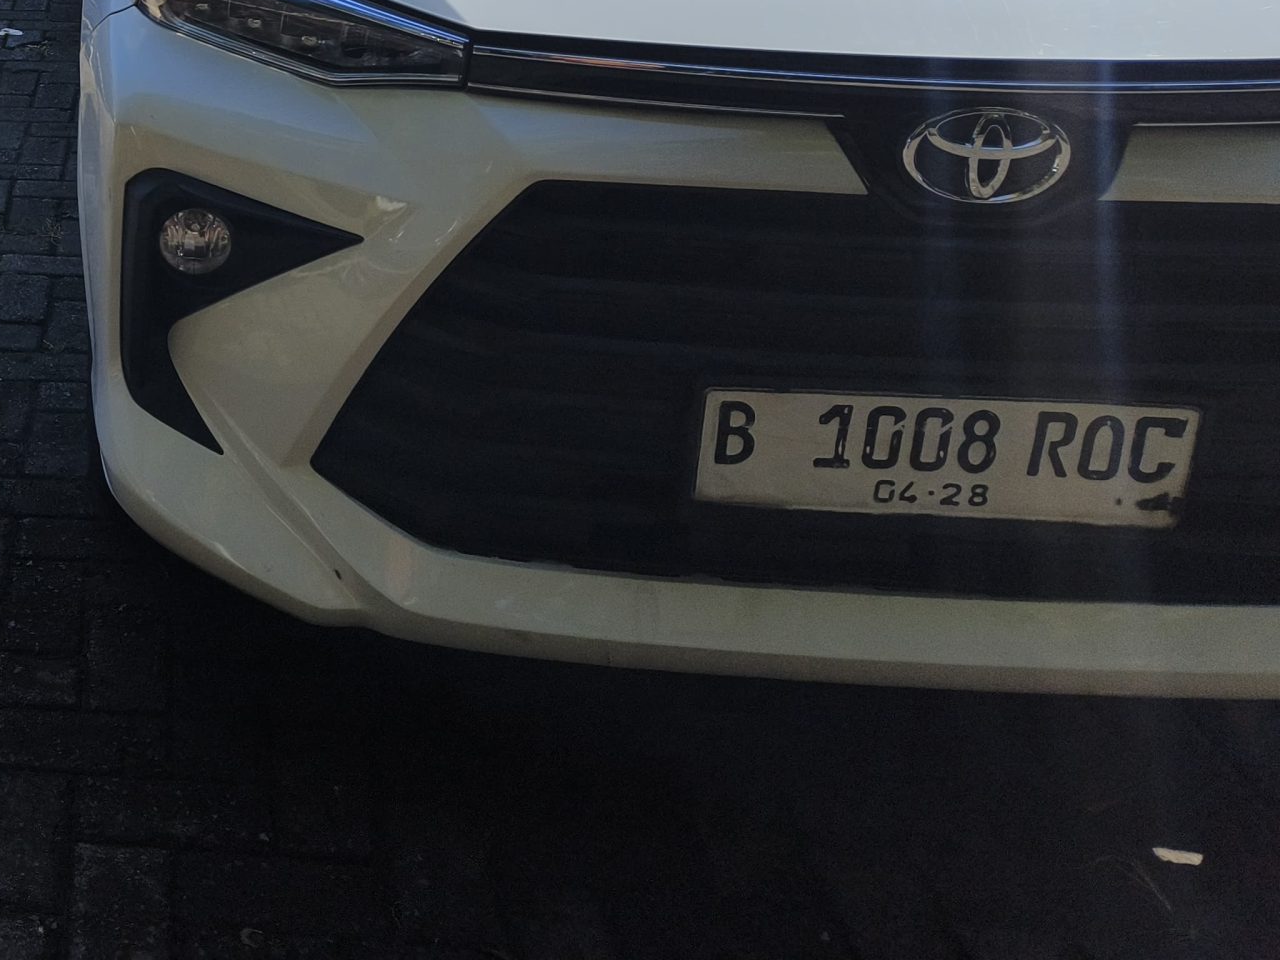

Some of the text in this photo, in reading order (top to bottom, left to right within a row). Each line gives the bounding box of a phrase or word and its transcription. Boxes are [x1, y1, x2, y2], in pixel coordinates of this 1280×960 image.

[713, 399, 1189, 484] B 1008 ROC
